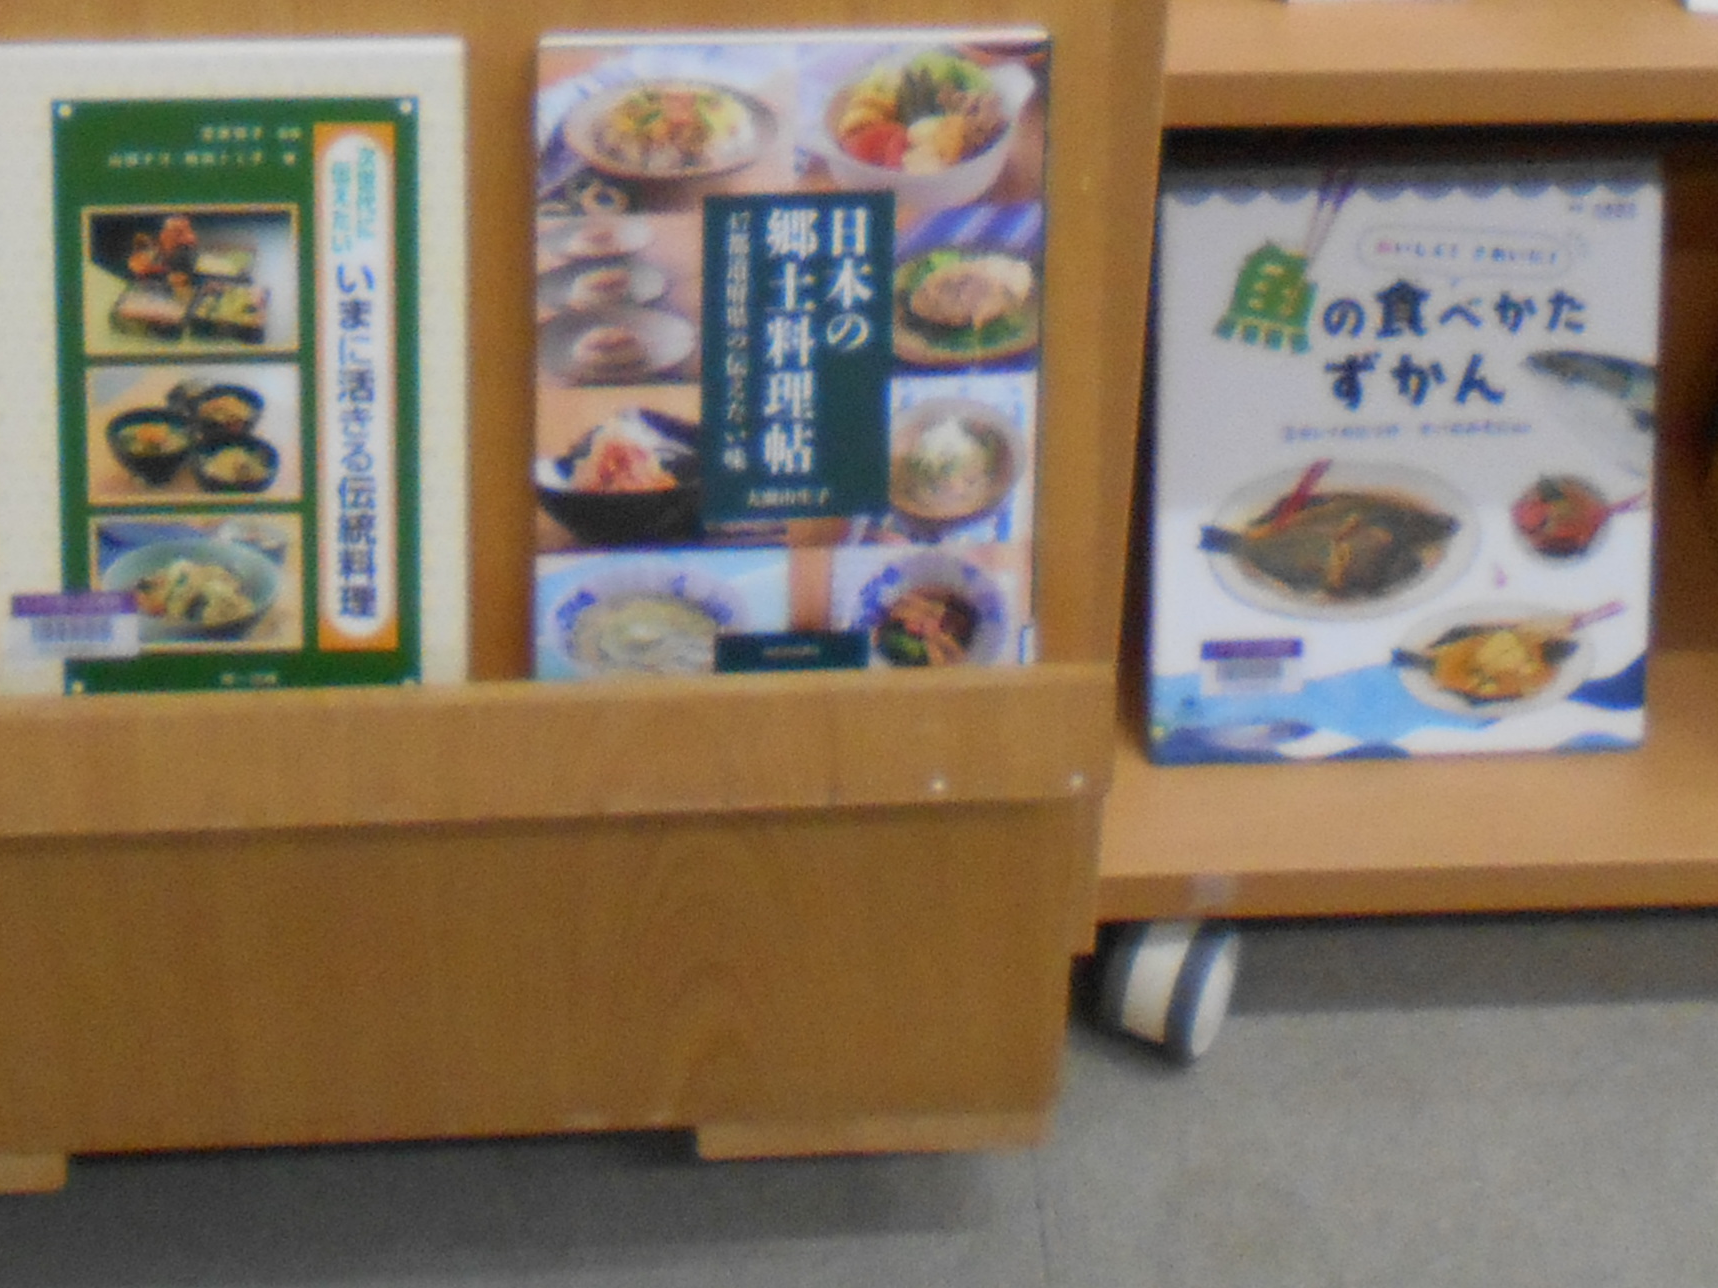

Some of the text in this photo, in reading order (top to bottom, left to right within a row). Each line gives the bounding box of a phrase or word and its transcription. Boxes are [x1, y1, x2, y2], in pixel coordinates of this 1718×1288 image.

[761, 205, 821, 477] 郷土料理帖
[826, 207, 877, 353] 日本の
[1324, 352, 1507, 411] ずかん
